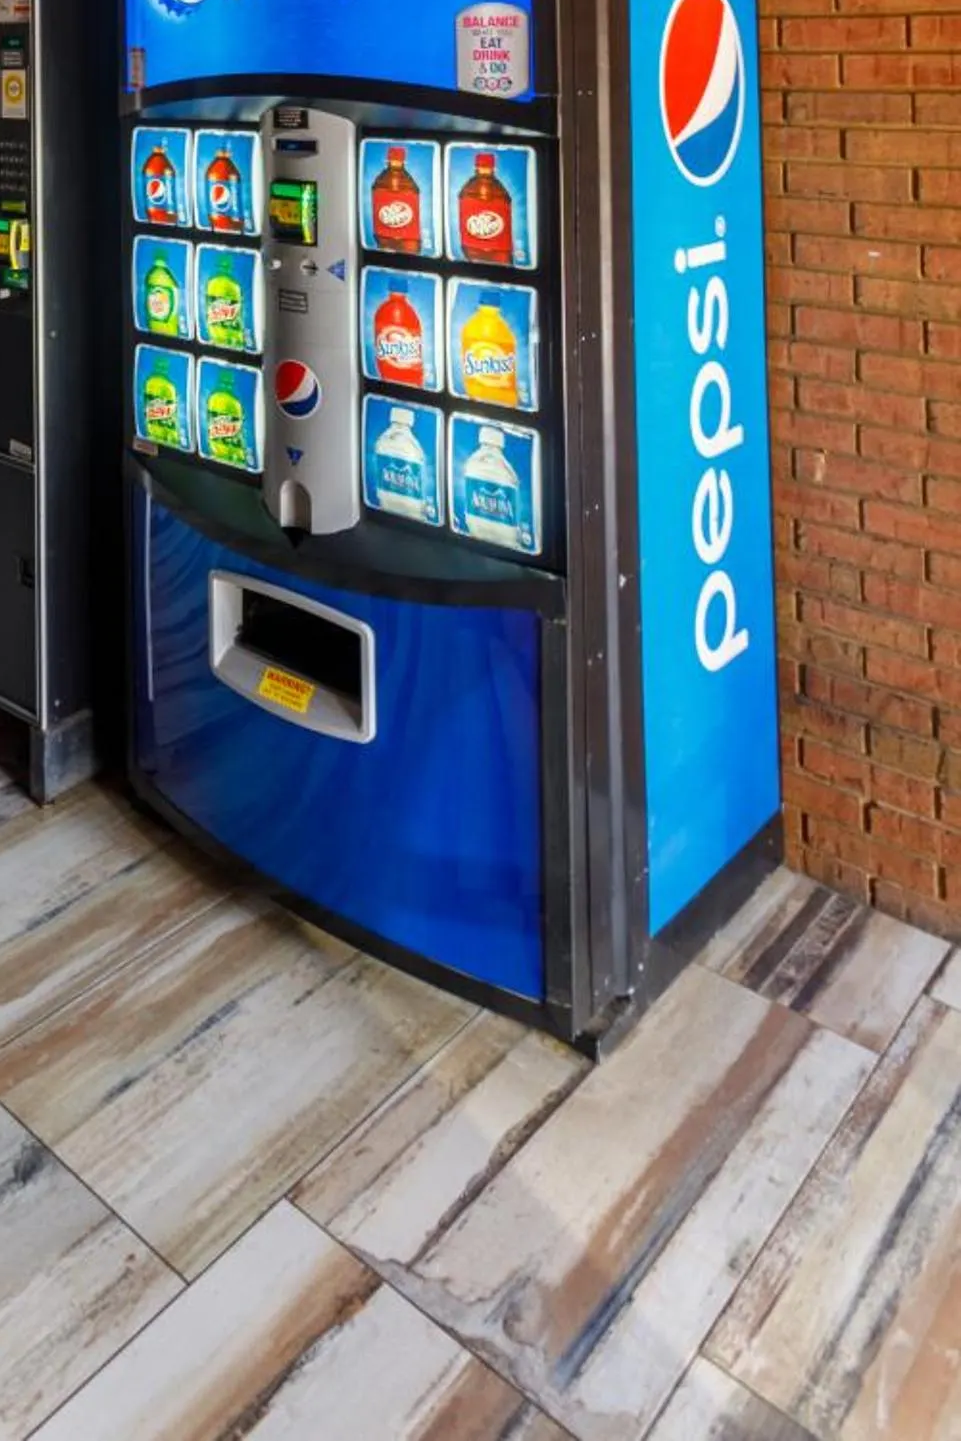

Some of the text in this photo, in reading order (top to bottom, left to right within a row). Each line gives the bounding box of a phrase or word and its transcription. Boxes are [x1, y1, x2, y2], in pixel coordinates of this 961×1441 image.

[480, 37, 502, 49] EAT
[473, 49, 510, 62] DRINK
[674, 247, 749, 673] pepsi
